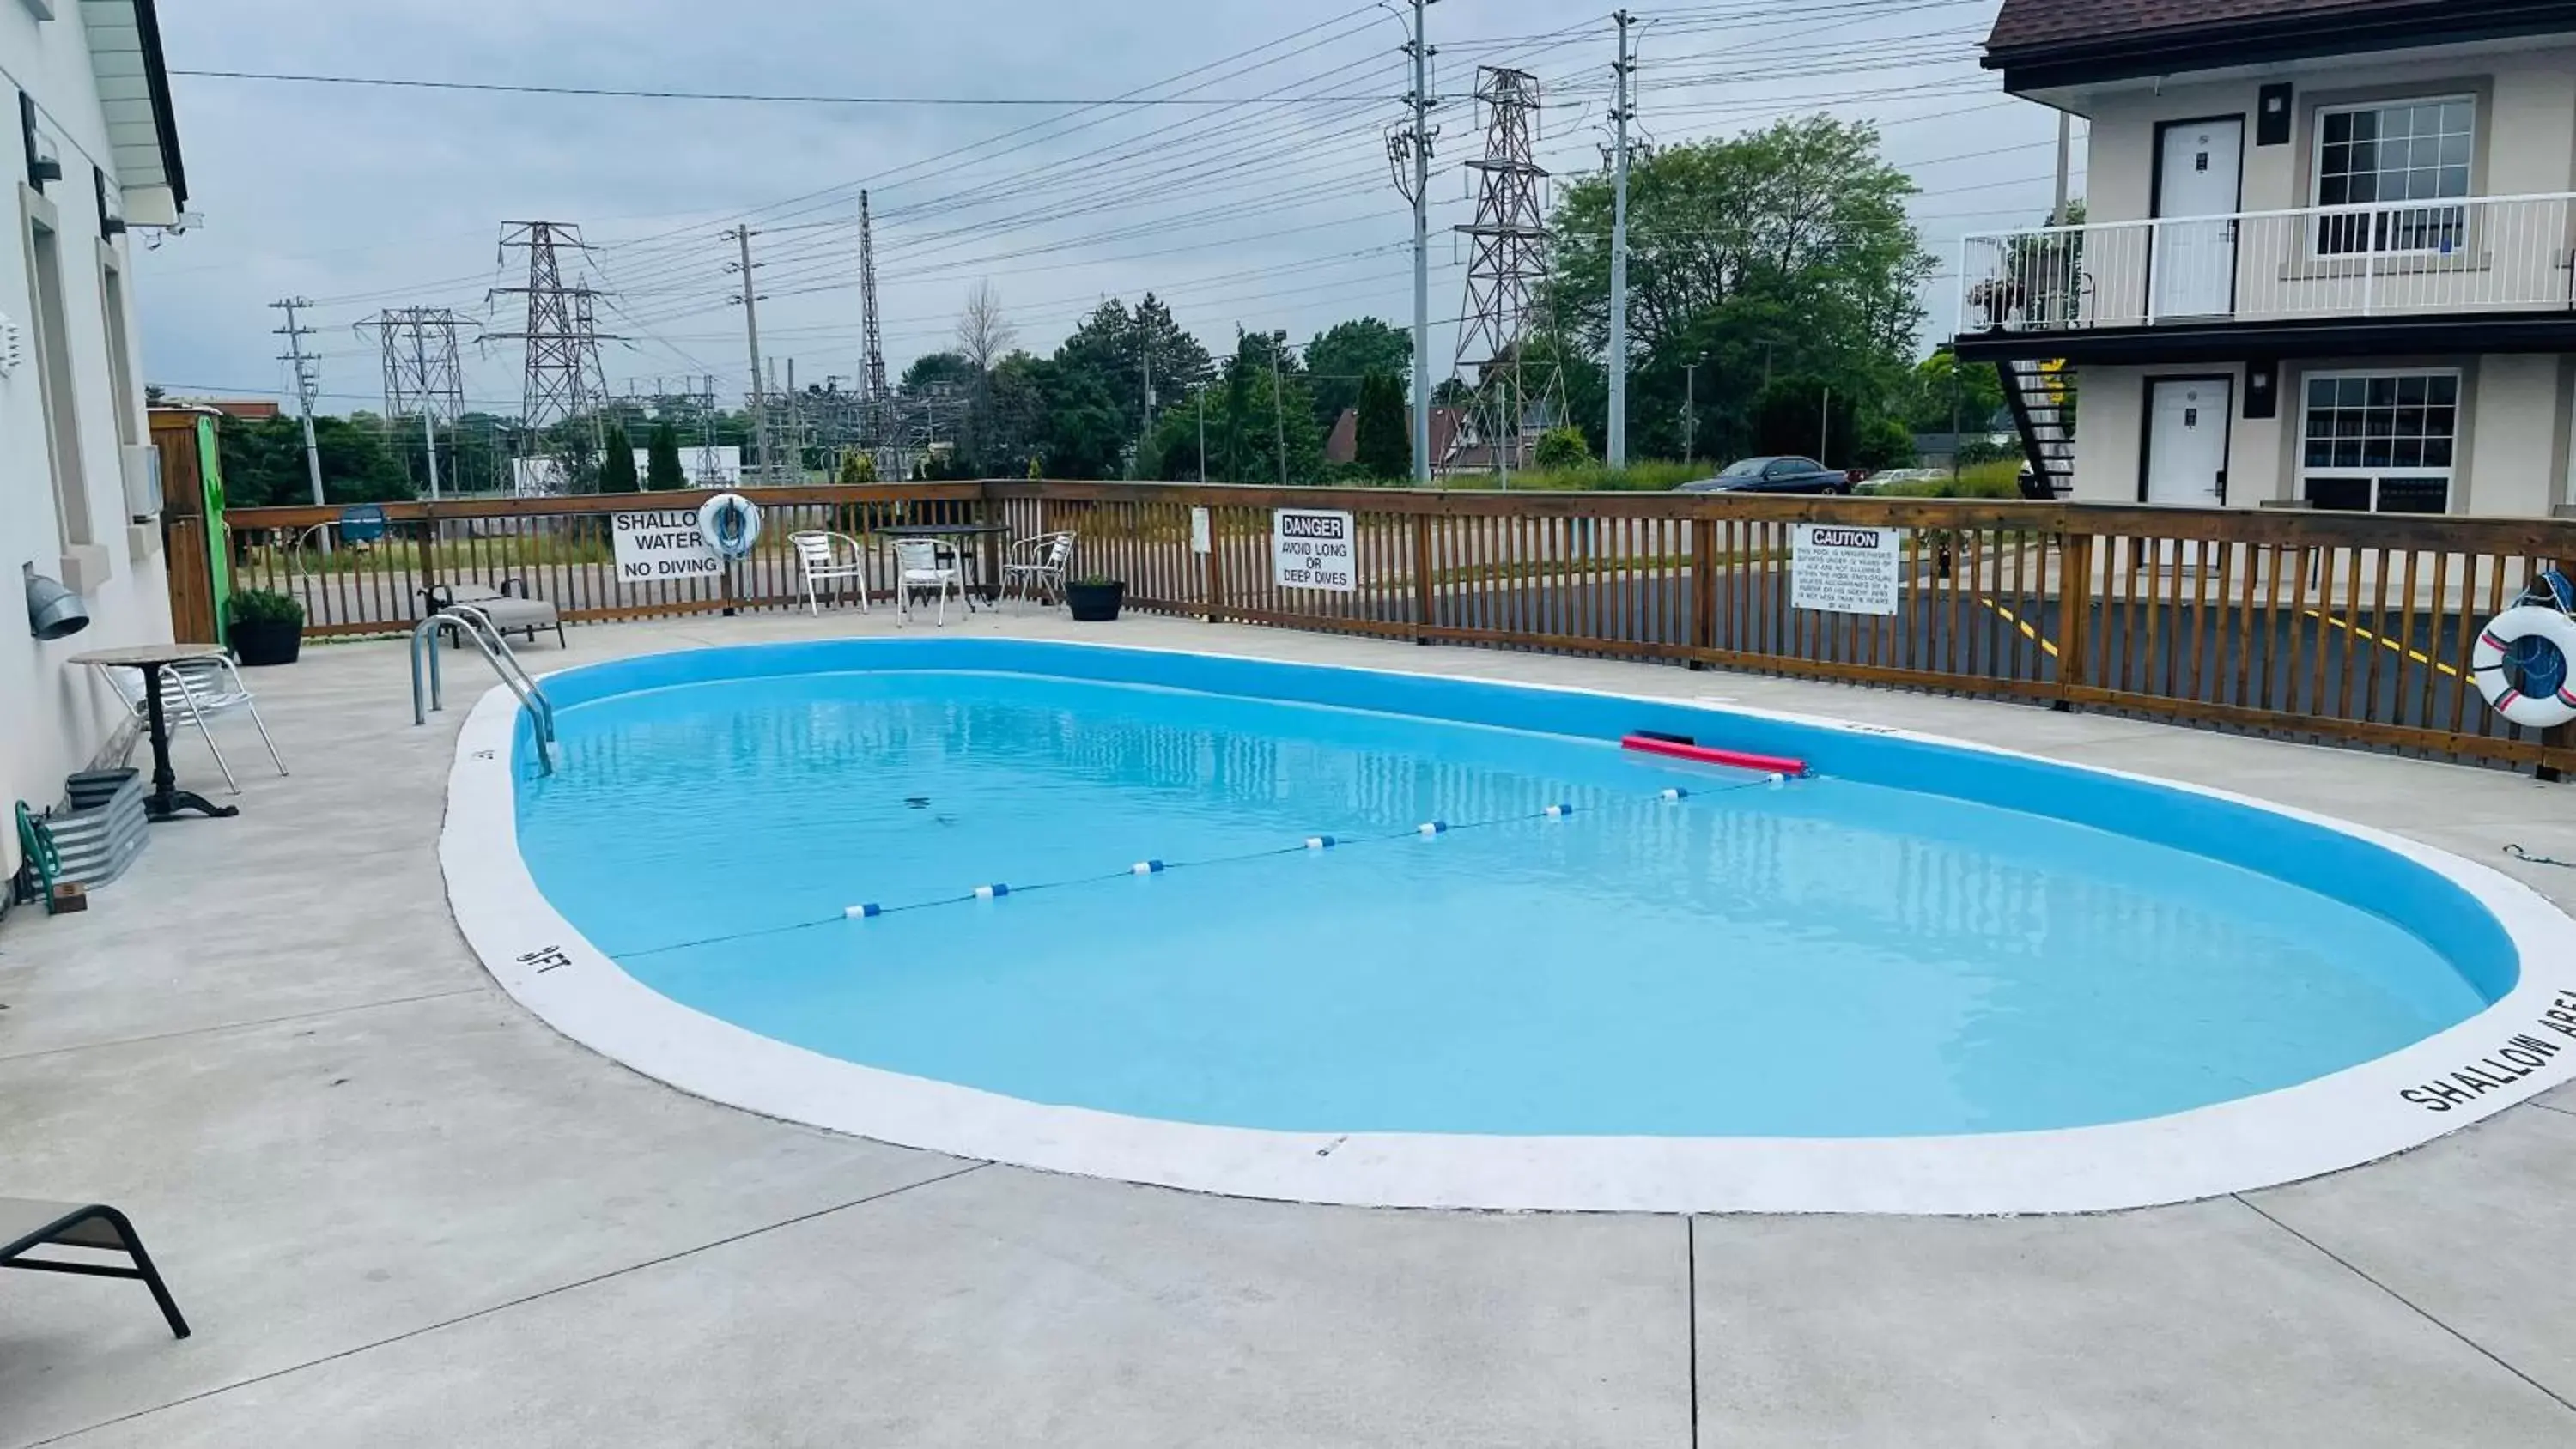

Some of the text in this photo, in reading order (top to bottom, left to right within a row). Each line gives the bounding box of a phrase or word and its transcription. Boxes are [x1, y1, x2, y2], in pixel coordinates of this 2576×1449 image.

[617, 511, 697, 530] SHALLO
[1284, 518, 1341, 537] DANGER
[635, 532, 702, 550] WATER
[1814, 530, 1876, 547] CAUTION
[1282, 542, 1347, 557] AVOID LONG
[624, 558, 717, 577] NO DIVING
[1306, 556, 1321, 568] OR
[1284, 569, 1347, 585] DEEP DIVES
[2400, 1033, 2561, 1112] SHALLOW
